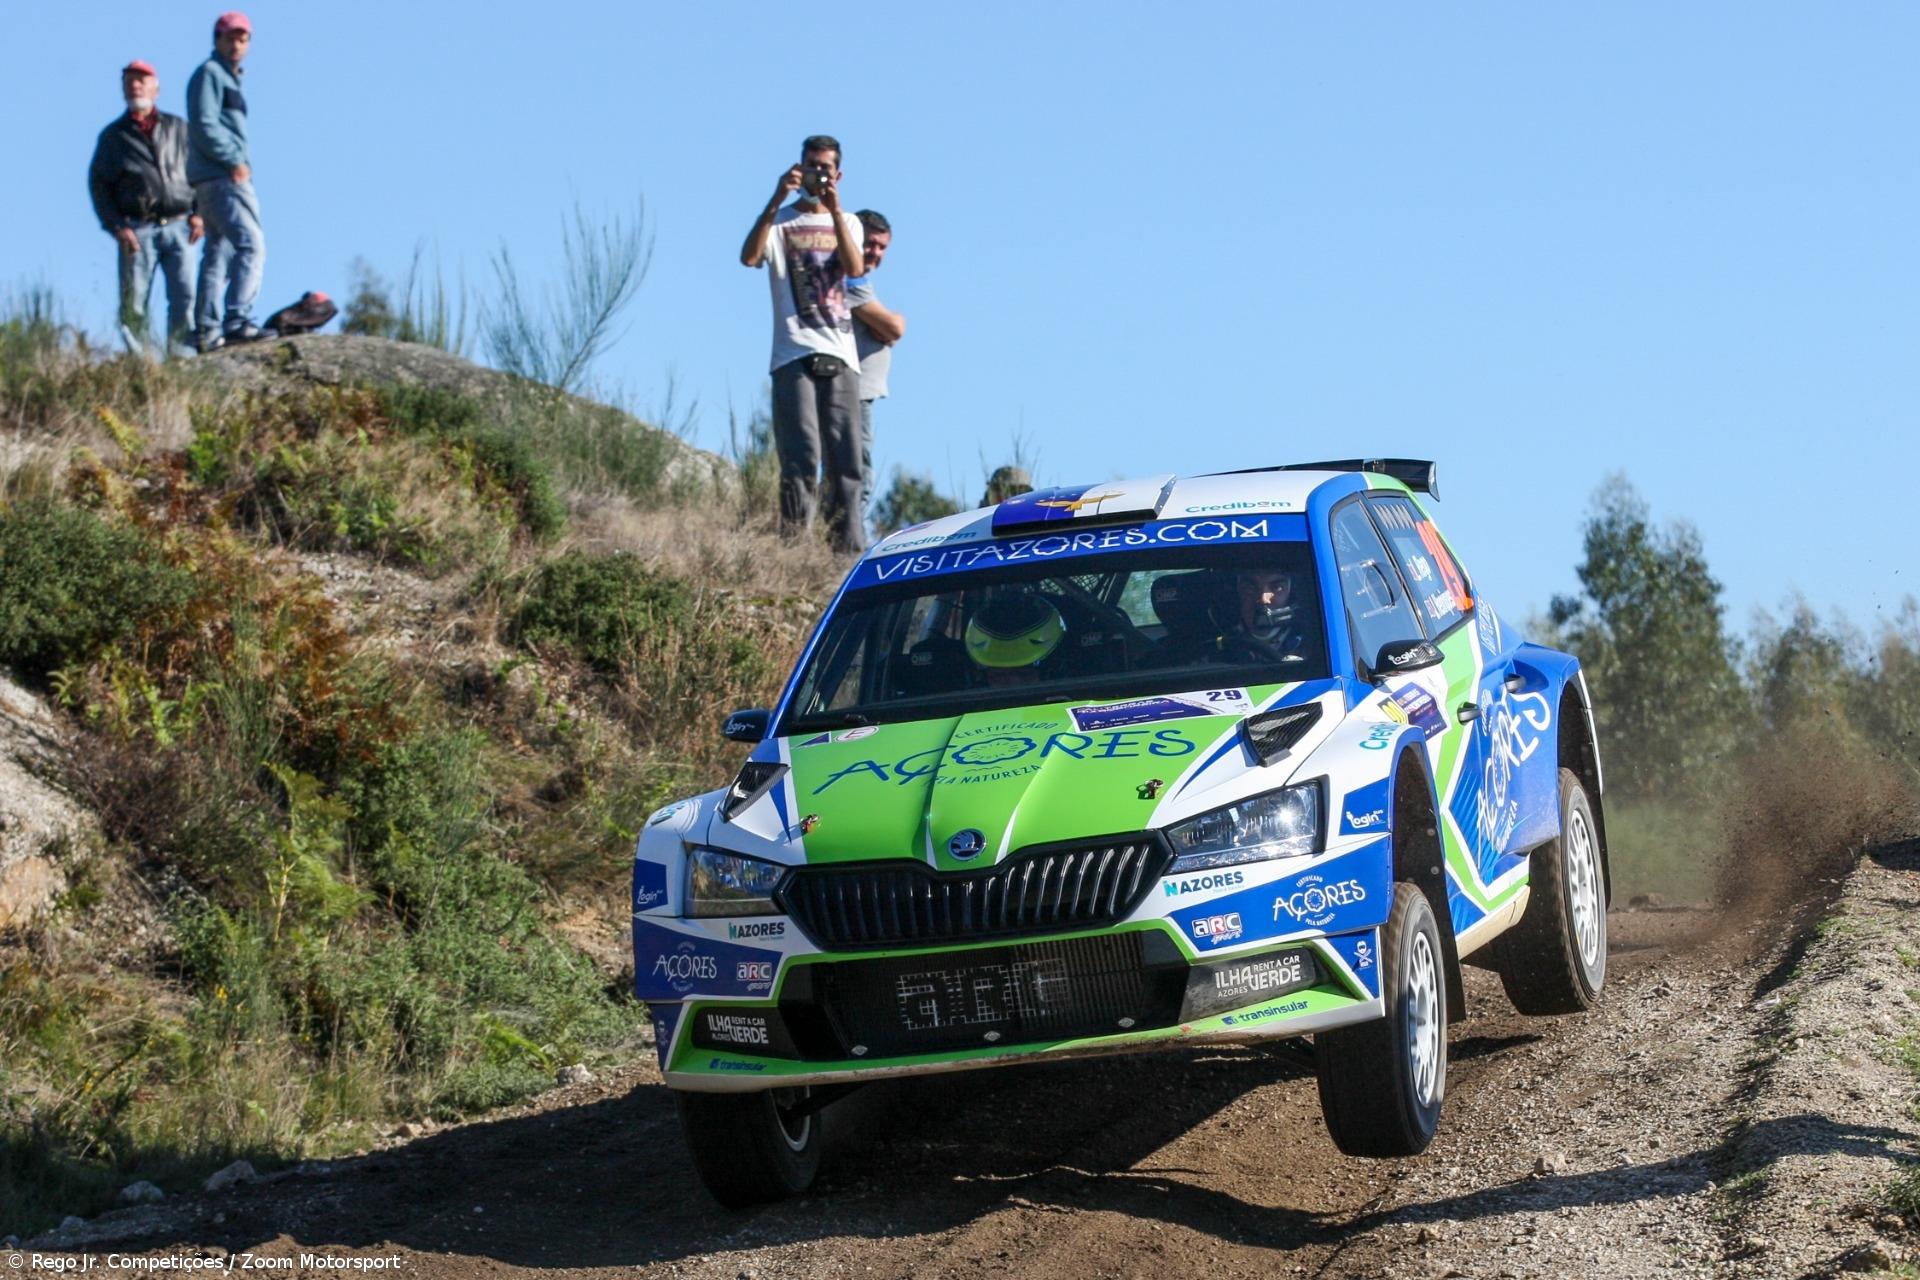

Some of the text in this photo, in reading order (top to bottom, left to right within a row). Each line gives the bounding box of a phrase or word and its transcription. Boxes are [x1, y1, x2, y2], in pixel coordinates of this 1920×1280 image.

[875, 519, 1269, 581] VISITAZORES.COM
[1206, 689, 1242, 702] 29
[955, 721, 1059, 739] CERTIFICADO
[811, 727, 1196, 797] AÇORES
[959, 764, 1042, 786] NATUREZA
[1272, 879, 1366, 921] AÇORES
[651, 954, 718, 982] AÇORES
[1253, 955, 1300, 972] RENT A CAR
[1217, 985, 1248, 999] AZORES
[752, 1018, 765, 1026] CAR
[1239, 1000, 1309, 1023] transinsular
